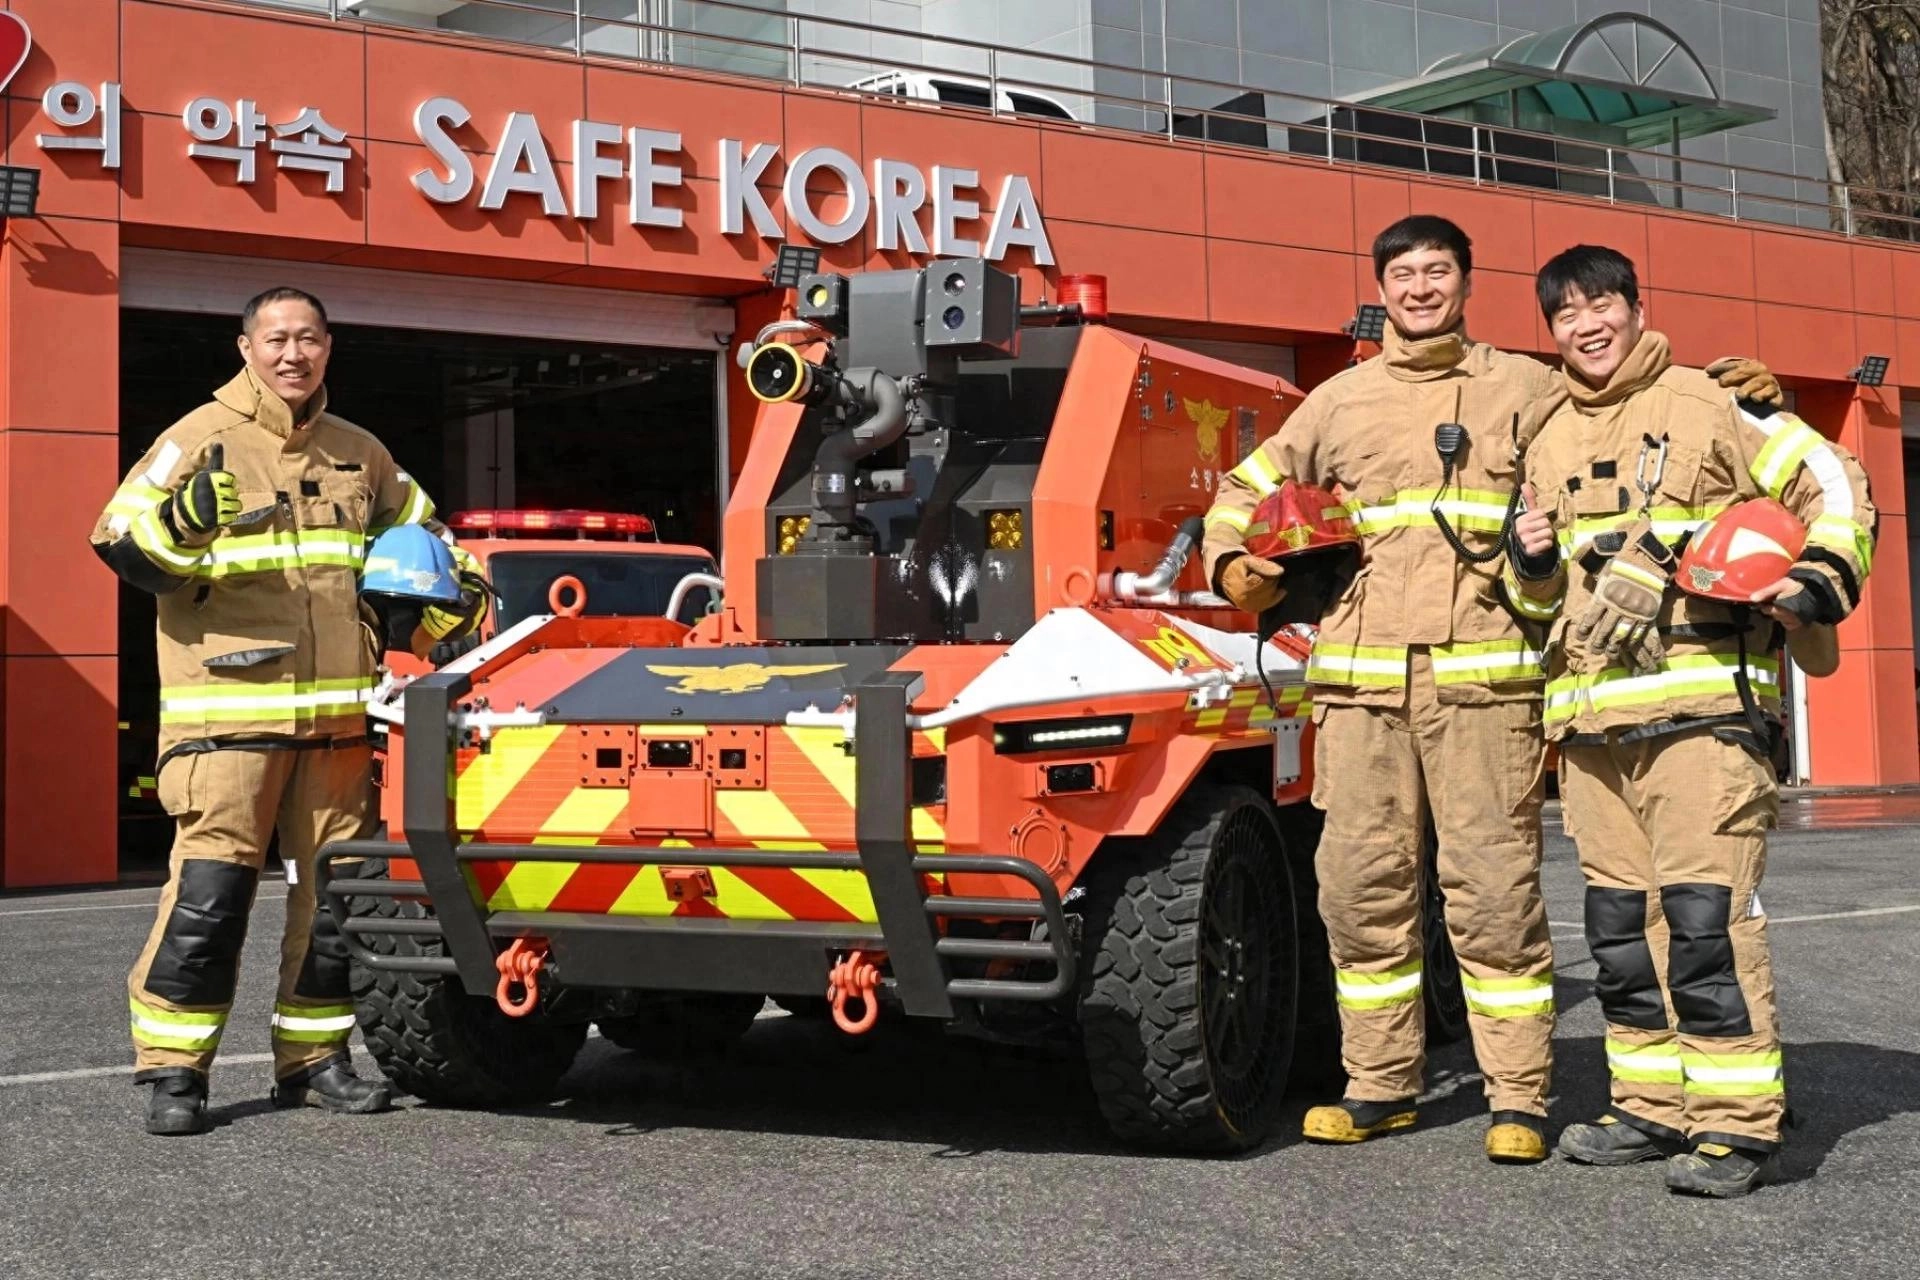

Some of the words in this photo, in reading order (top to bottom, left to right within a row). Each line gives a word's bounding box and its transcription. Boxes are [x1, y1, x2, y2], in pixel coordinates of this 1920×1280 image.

[37, 80, 121, 168] 의
[183, 97, 351, 192] 약속
[409, 96, 683, 228] SAFE
[719, 138, 1055, 266] KOREA
